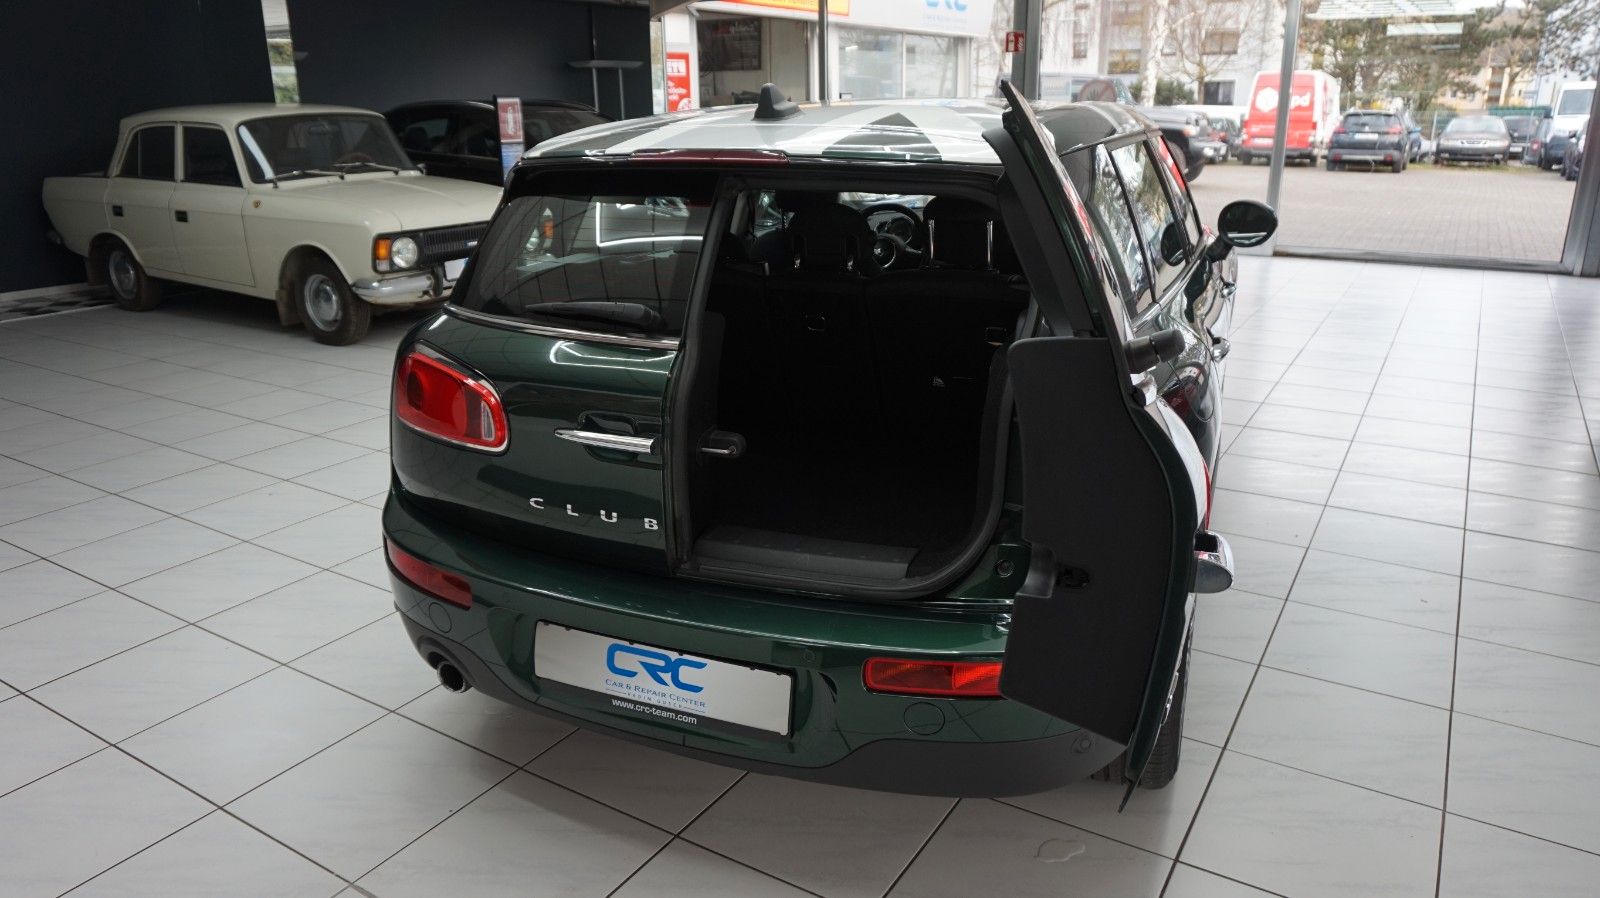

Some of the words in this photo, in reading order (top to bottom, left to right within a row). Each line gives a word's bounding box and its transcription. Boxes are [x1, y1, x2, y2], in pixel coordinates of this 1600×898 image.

[529, 497, 659, 531] CLUB
[606, 643, 708, 694] CRC
[612, 698, 697, 725] www.crc-team.com
